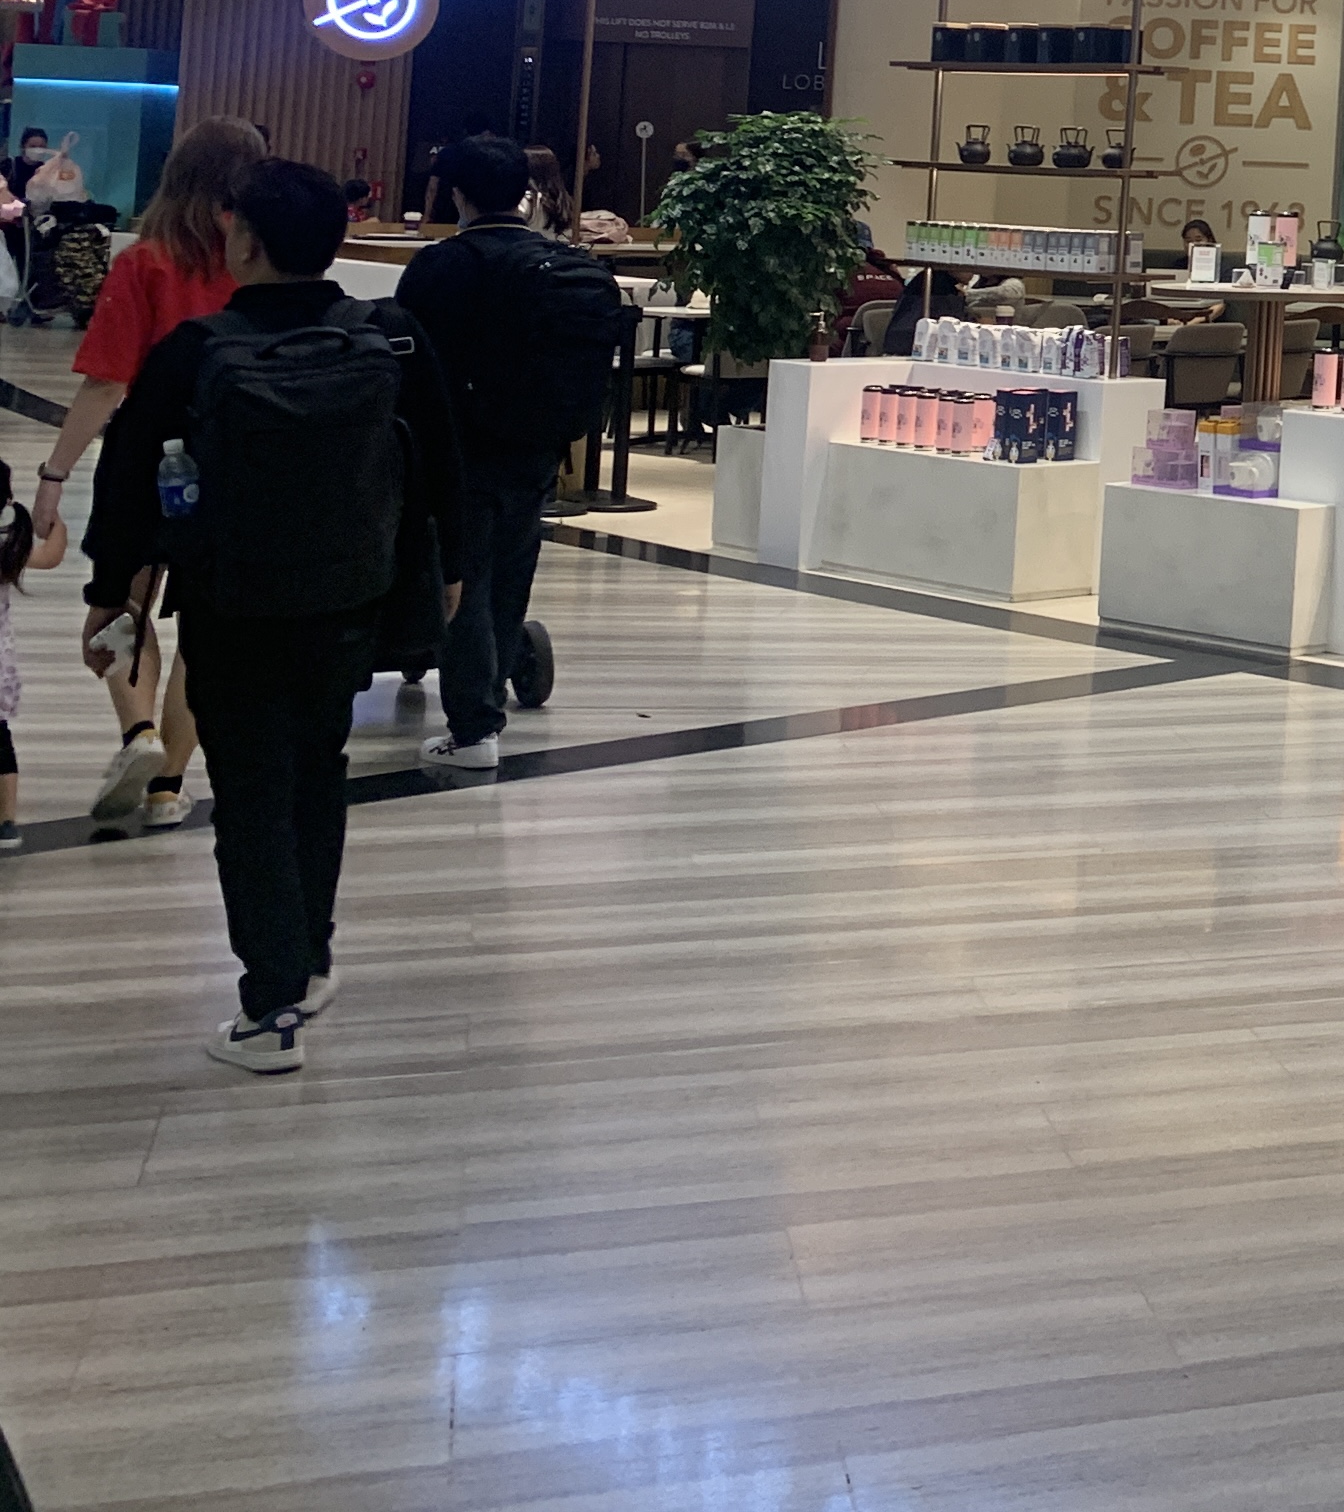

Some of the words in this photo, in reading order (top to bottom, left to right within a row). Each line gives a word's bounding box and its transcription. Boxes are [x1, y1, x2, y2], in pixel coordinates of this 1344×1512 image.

[1108, 15, 1317, 66] OFFEE
[1097, 74, 1153, 122] &
[1167, 69, 1313, 131] TEA
[1093, 194, 1206, 227] SNCE
